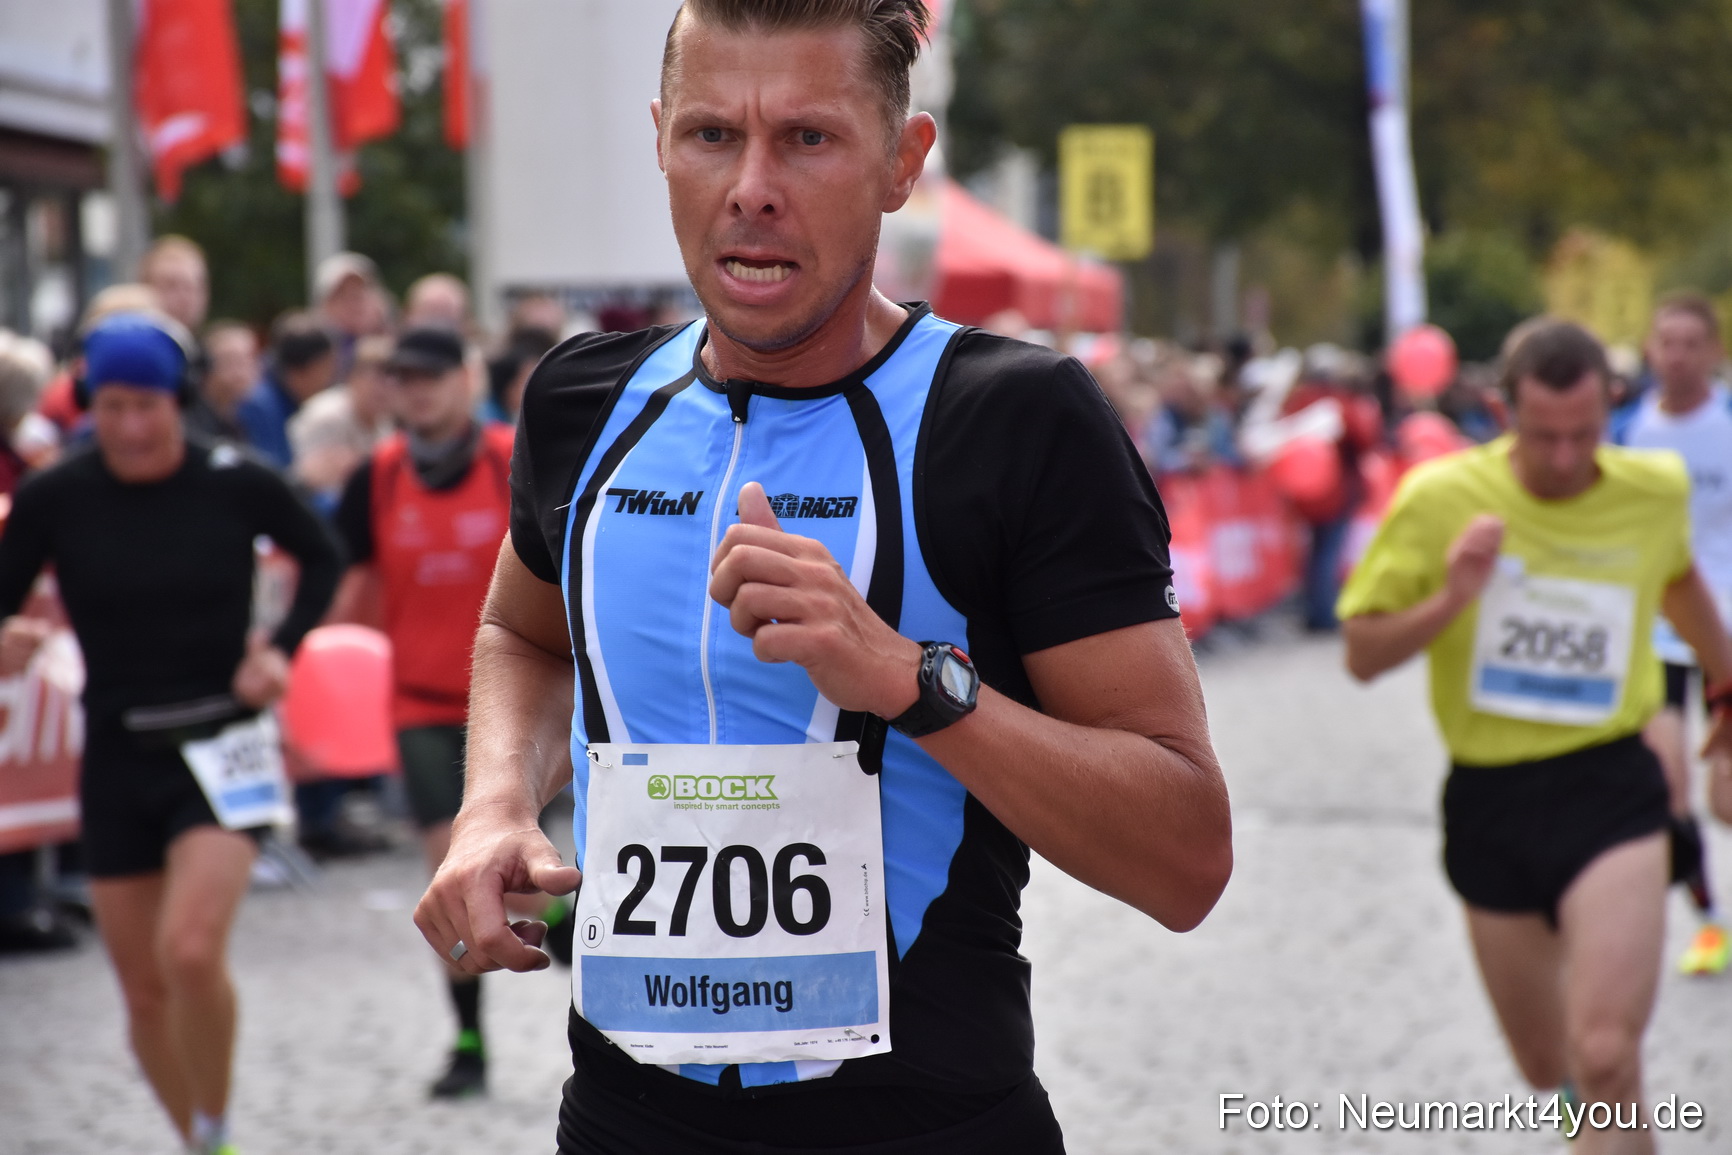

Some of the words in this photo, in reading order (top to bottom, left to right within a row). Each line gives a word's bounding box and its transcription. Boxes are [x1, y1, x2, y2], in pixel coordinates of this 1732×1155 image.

[1501, 616, 1608, 672] 2058
[674, 775, 778, 800] BOCK
[674, 802, 702, 811] inspired
[704, 802, 714, 811] by
[741, 802, 780, 811] concepts
[612, 842, 832, 938] 2706
[588, 924, 597, 941] D
[644, 975, 794, 1014] Wolfgang
